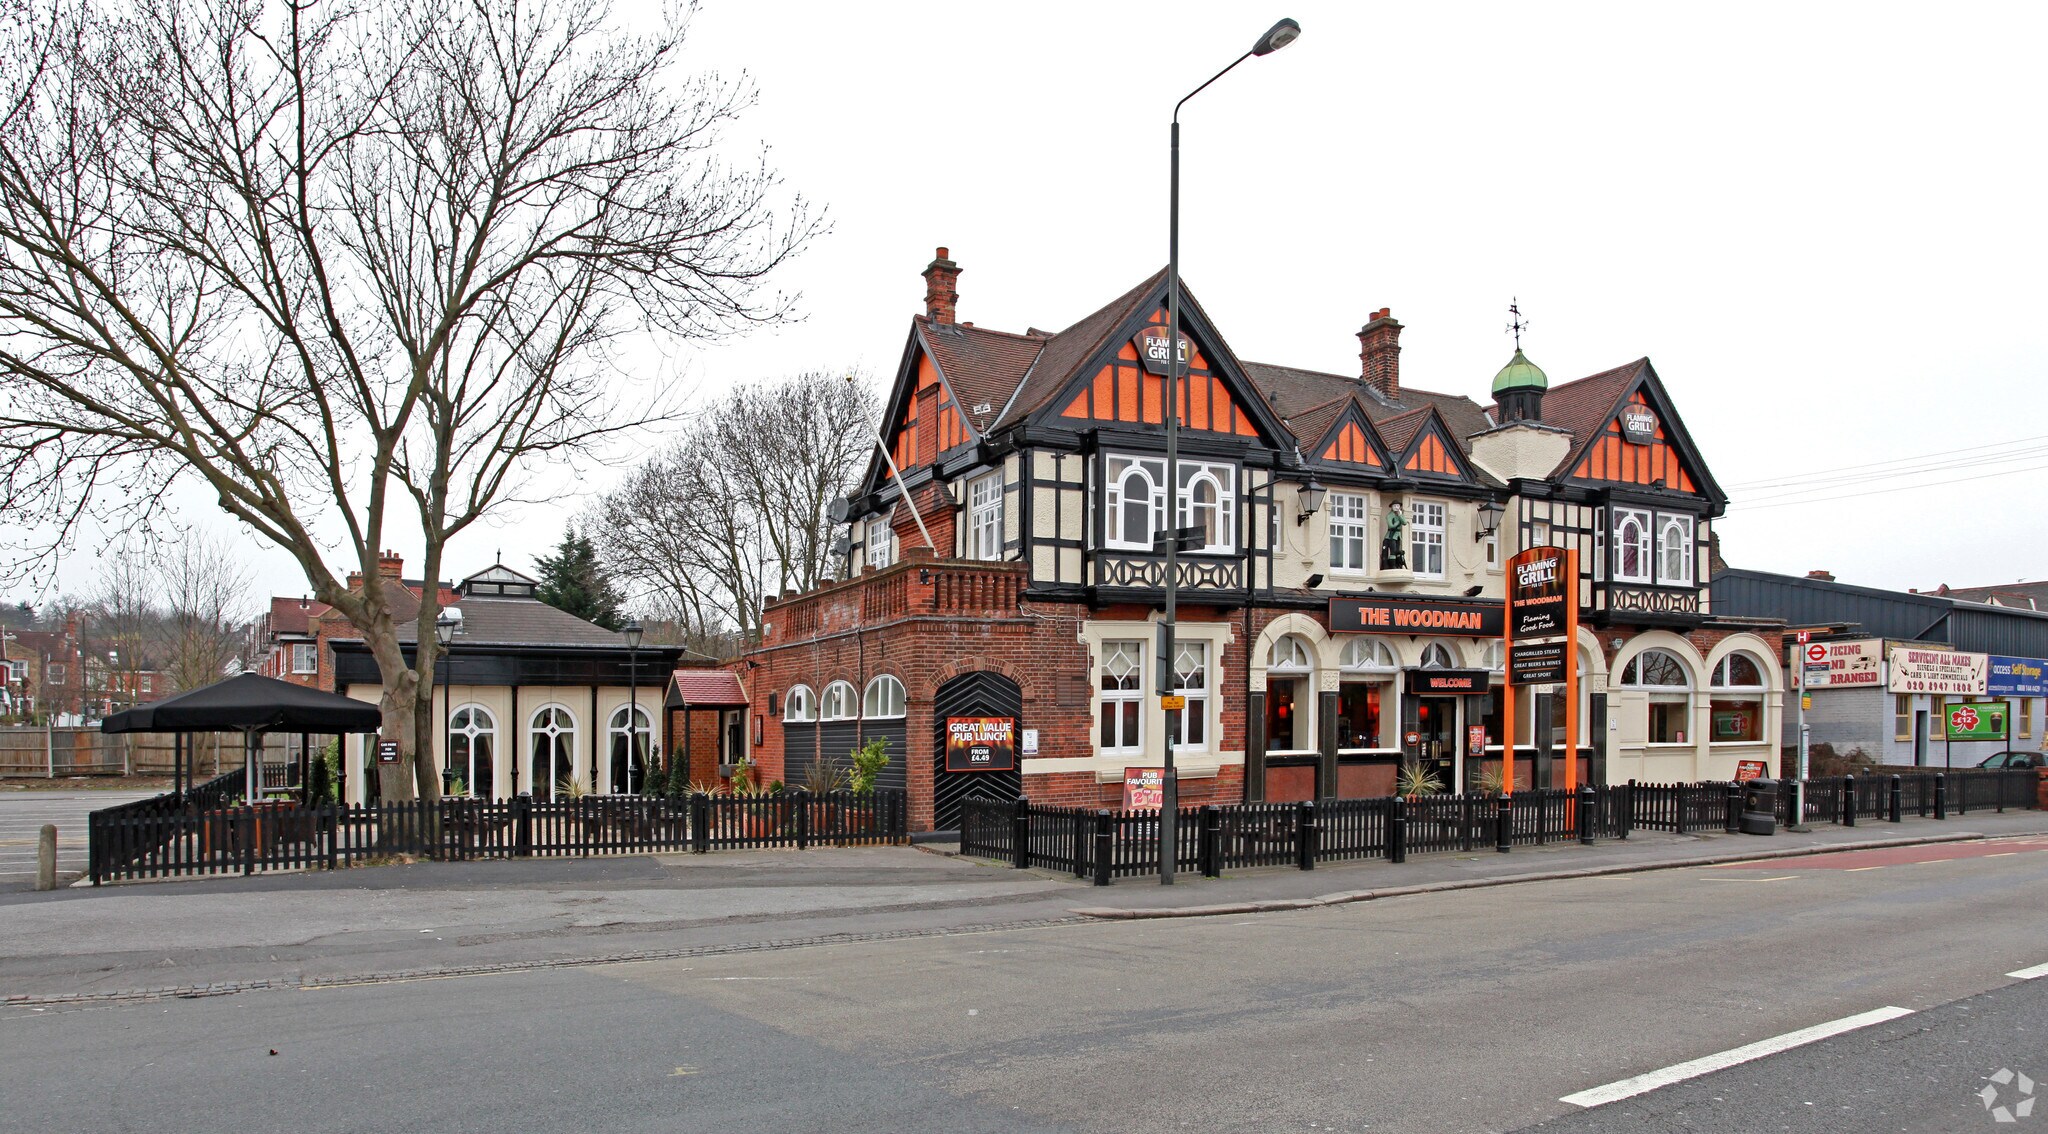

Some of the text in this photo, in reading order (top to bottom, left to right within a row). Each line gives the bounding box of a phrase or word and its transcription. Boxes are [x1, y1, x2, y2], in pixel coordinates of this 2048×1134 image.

[1146, 338, 1186, 349] FLAMG
[1148, 346, 1185, 361] GRIL
[1626, 414, 1653, 423] FLAMING
[1628, 421, 1652, 432] GRILL
[1517, 559, 1556, 575] FLAMING
[1519, 568, 1555, 585] GRILL
[1526, 595, 1562, 606] WOODMAN
[1359, 607, 1482, 629] THE WOODMAN
[1523, 613, 1550, 623] Flaming
[1520, 620, 1555, 633] Good Food
[1798, 632, 1806, 642] H
[1831, 659, 1845, 670] ND
[1908, 652, 1971, 667] SERVICING ALL MAKES
[1940, 673, 1968, 681] COMMERCIALS
[1993, 663, 2041, 680] access Self Storage
[1430, 677, 1472, 688] WELCOME
[1830, 671, 1877, 685] RRANGED
[1906, 681, 1924, 690] 020
[1961, 709, 1967, 717] 4
[949, 723, 1012, 733] GREAT VALUE
[954, 732, 1007, 742] PUB LUNCH
[1133, 792, 1143, 804] 2
